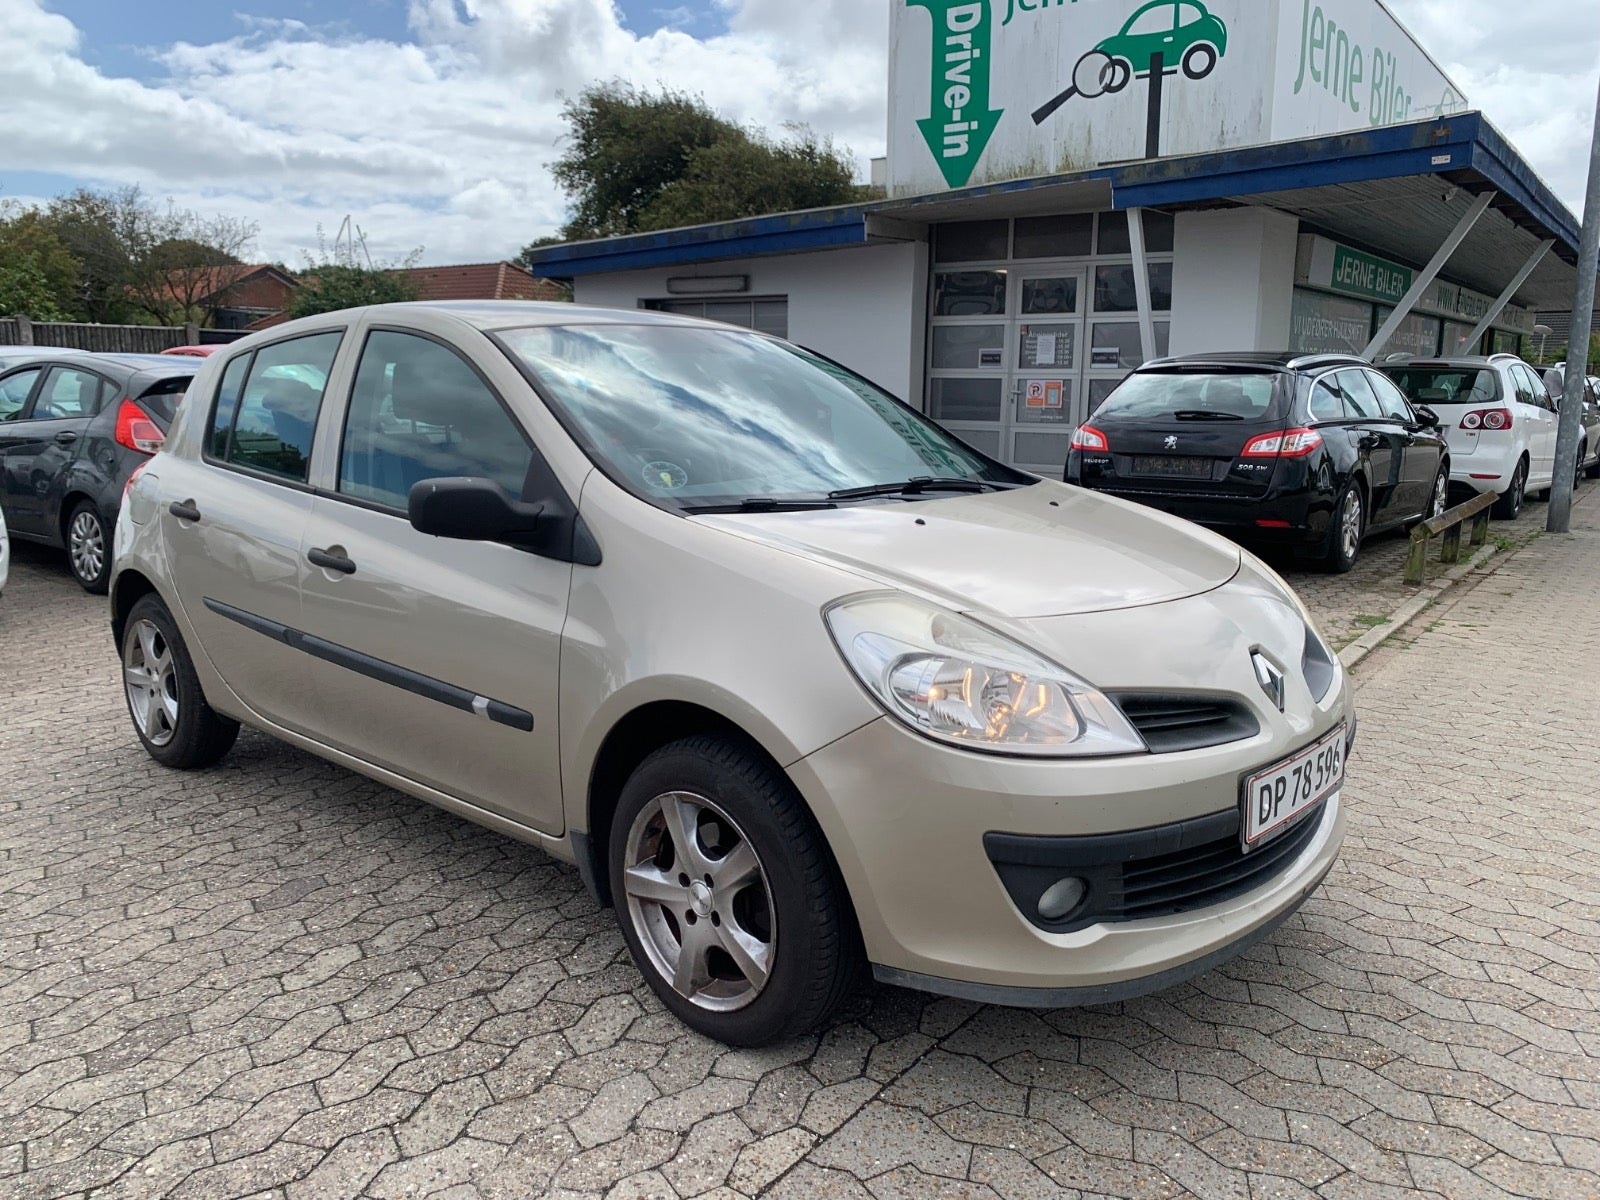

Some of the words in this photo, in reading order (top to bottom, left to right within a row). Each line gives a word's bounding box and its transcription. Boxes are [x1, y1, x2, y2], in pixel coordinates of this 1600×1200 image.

[943, 2, 982, 158] Drive-in
[1294, 0, 1363, 112] Jerne
[1337, 256, 1376, 289] JERNE
[1376, 267, 1404, 297] BILER
[1259, 776, 1287, 826] DP
[1292, 759, 1313, 807] 78
[1315, 739, 1340, 791] 596
